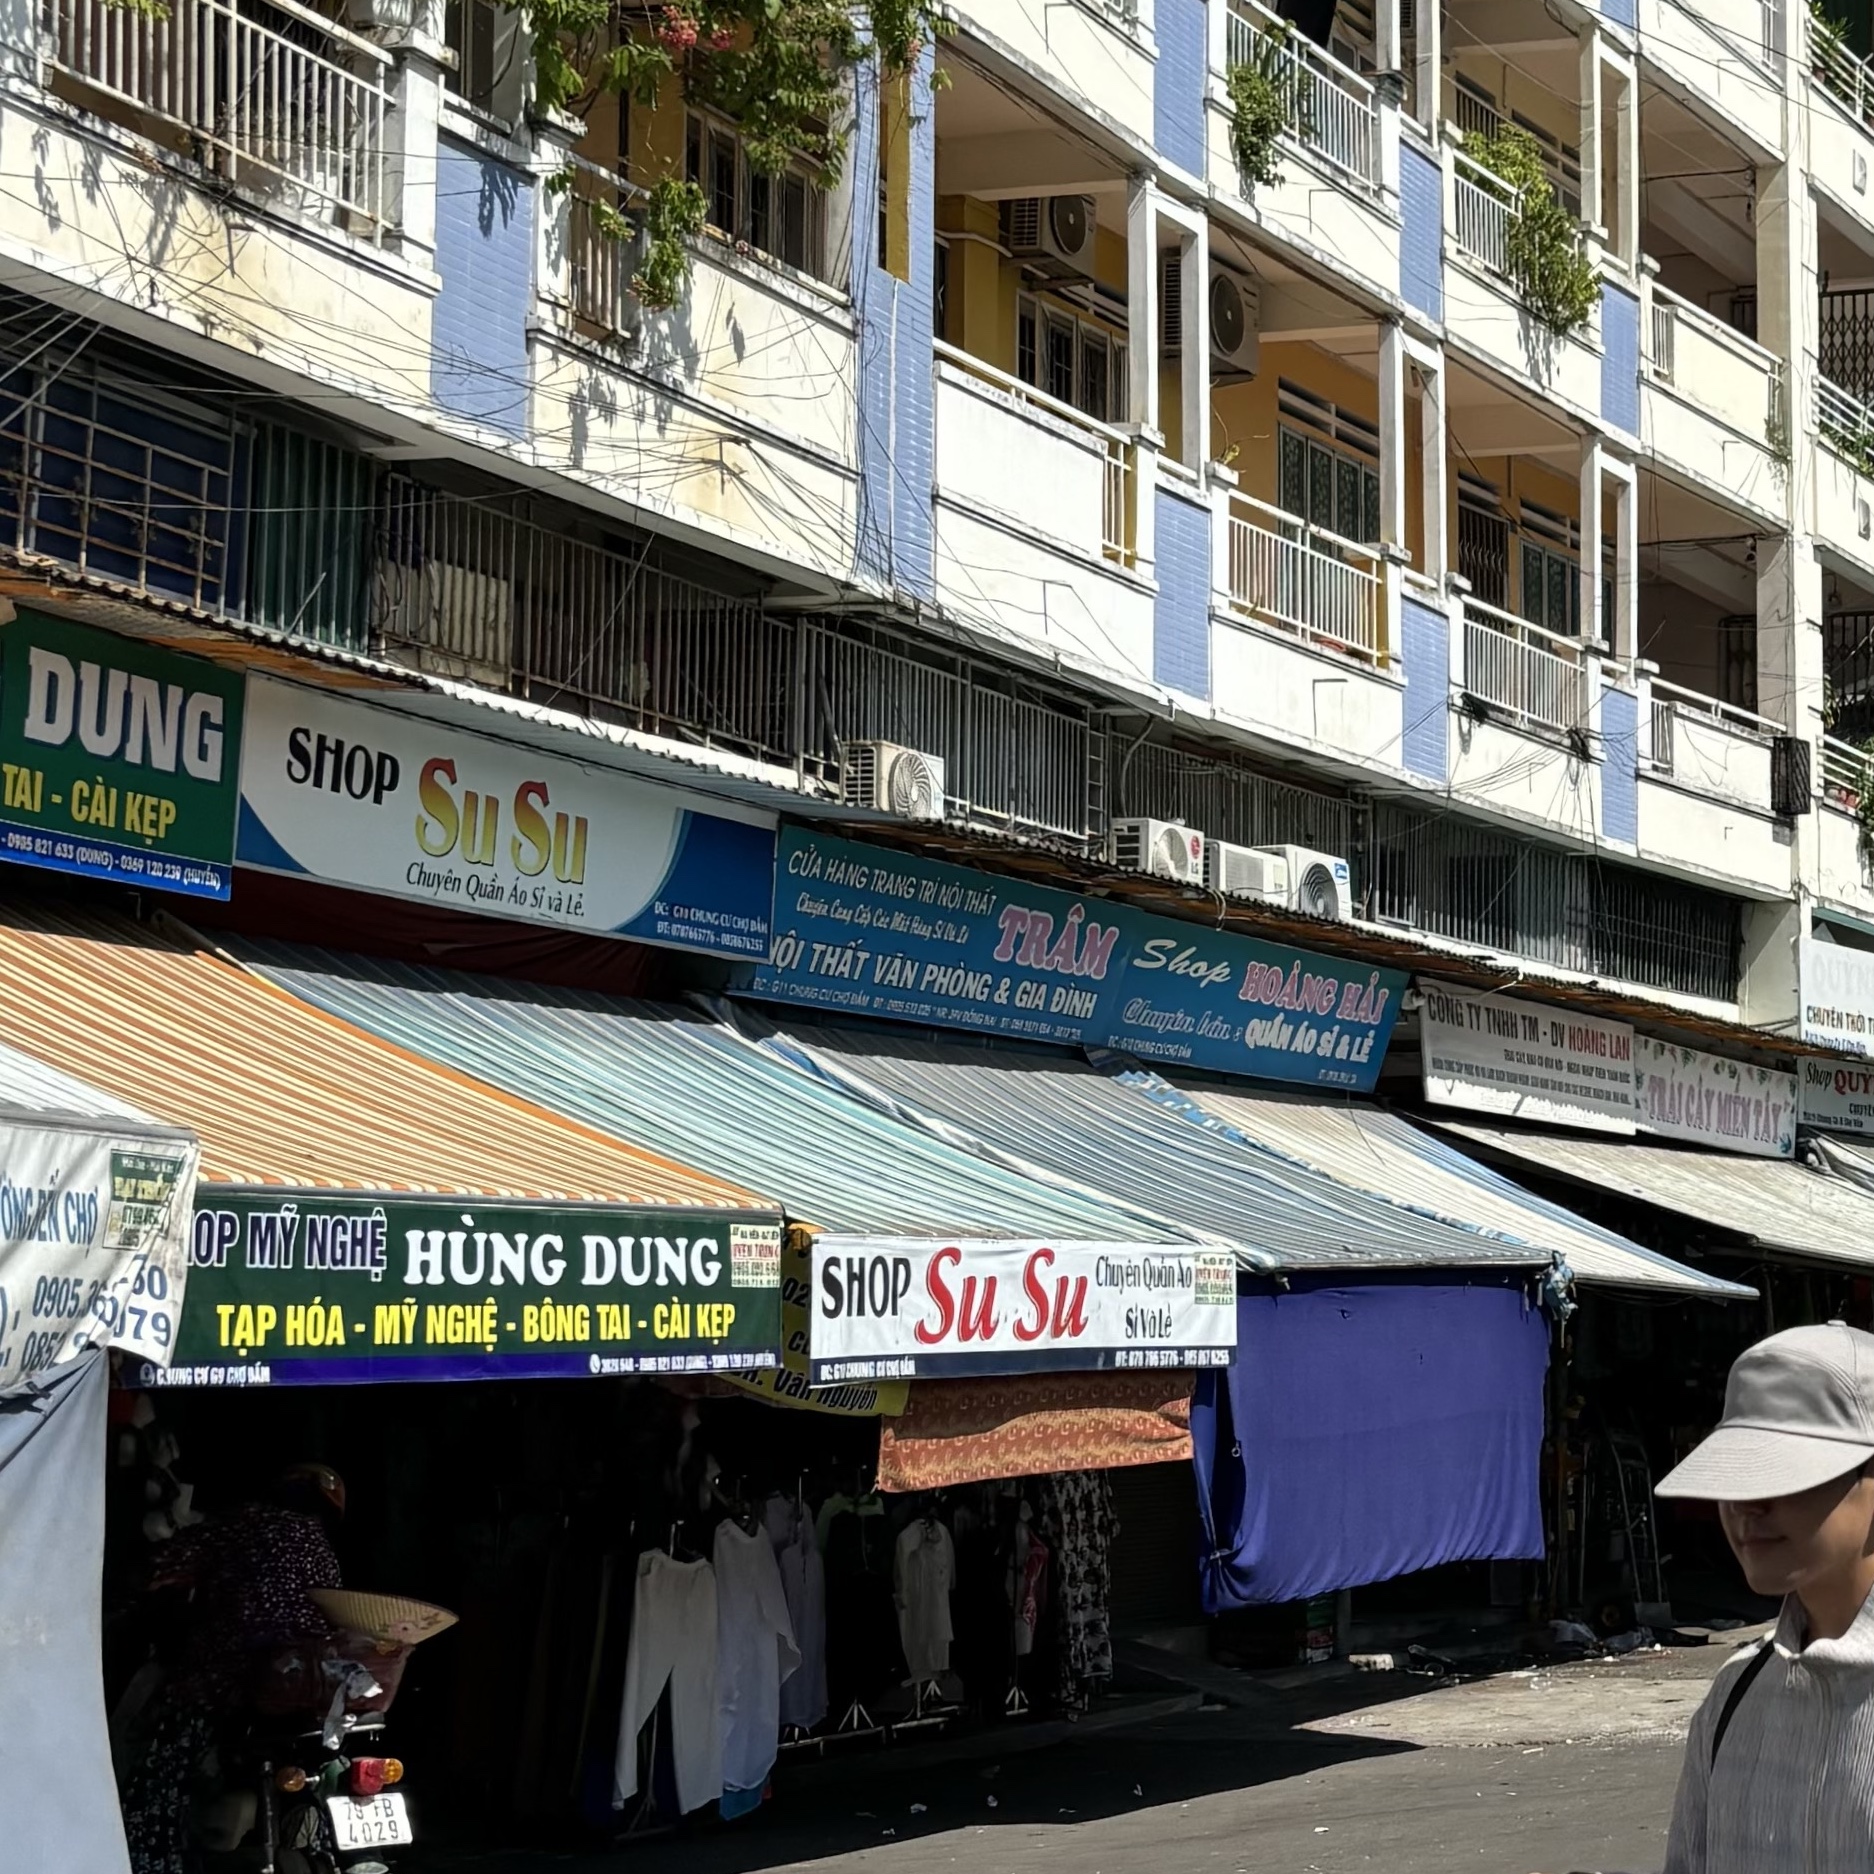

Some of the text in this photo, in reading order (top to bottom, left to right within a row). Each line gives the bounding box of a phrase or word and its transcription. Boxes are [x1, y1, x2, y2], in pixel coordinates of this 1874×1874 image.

[24, 646, 223, 782] DUNG
[2, 763, 43, 812] TAI
[71, 775, 117, 829] CÀI
[124, 790, 176, 844] KẸP
[286, 726, 589, 886] SHOP Su Su
[407, 862, 461, 896] Chuyên
[466, 872, 505, 902] Quần
[508, 876, 528, 906] Áo
[548, 891, 562, 913] và
[870, 868, 917, 900] TRANG
[993, 903, 1120, 981] TRÂM
[1133, 939, 1231, 988] Shop
[808, 940, 871, 982] THẤT
[874, 952, 922, 989] VĂN
[920, 961, 993, 1004] PHÒNG
[993, 976, 1012, 1005] &
[1015, 980, 1049, 1012] GIA
[1050, 982, 1098, 1019] ĐÌNH
[1467, 1002, 1481, 1031] TY
[1484, 1006, 1518, 1039] TNHH
[1521, 1014, 1540, 1043] TM
[1551, 1021, 1565, 1048] DV
[1610, 1033, 1630, 1060] LAN
[1807, 1005, 1843, 1030] CHUYÊN
[1806, 1062, 1832, 1091] Shop
[246, 1203, 300, 1269] MỸ
[304, 1207, 387, 1282] NGHỆ
[403, 1213, 567, 1287] HÙNG
[581, 1233, 723, 1287] DUNG
[217, 1304, 277, 1356] TẠP
[286, 1296, 346, 1346] HÓA
[374, 1296, 418, 1345] MỸ
[426, 1296, 498, 1352] NGHỆ
[523, 1296, 590, 1343] BÔNG
[596, 1304, 631, 1341] TAI
[654, 1295, 690, 1340] CÀI
[697, 1303, 735, 1345] KẸP
[822, 1255, 912, 1319] SHOP
[914, 1247, 998, 1345] Su
[1012, 1247, 1089, 1342] Su
[1096, 1255, 1140, 1295] Chuyên
[350, 1820, 399, 1843] 4029
